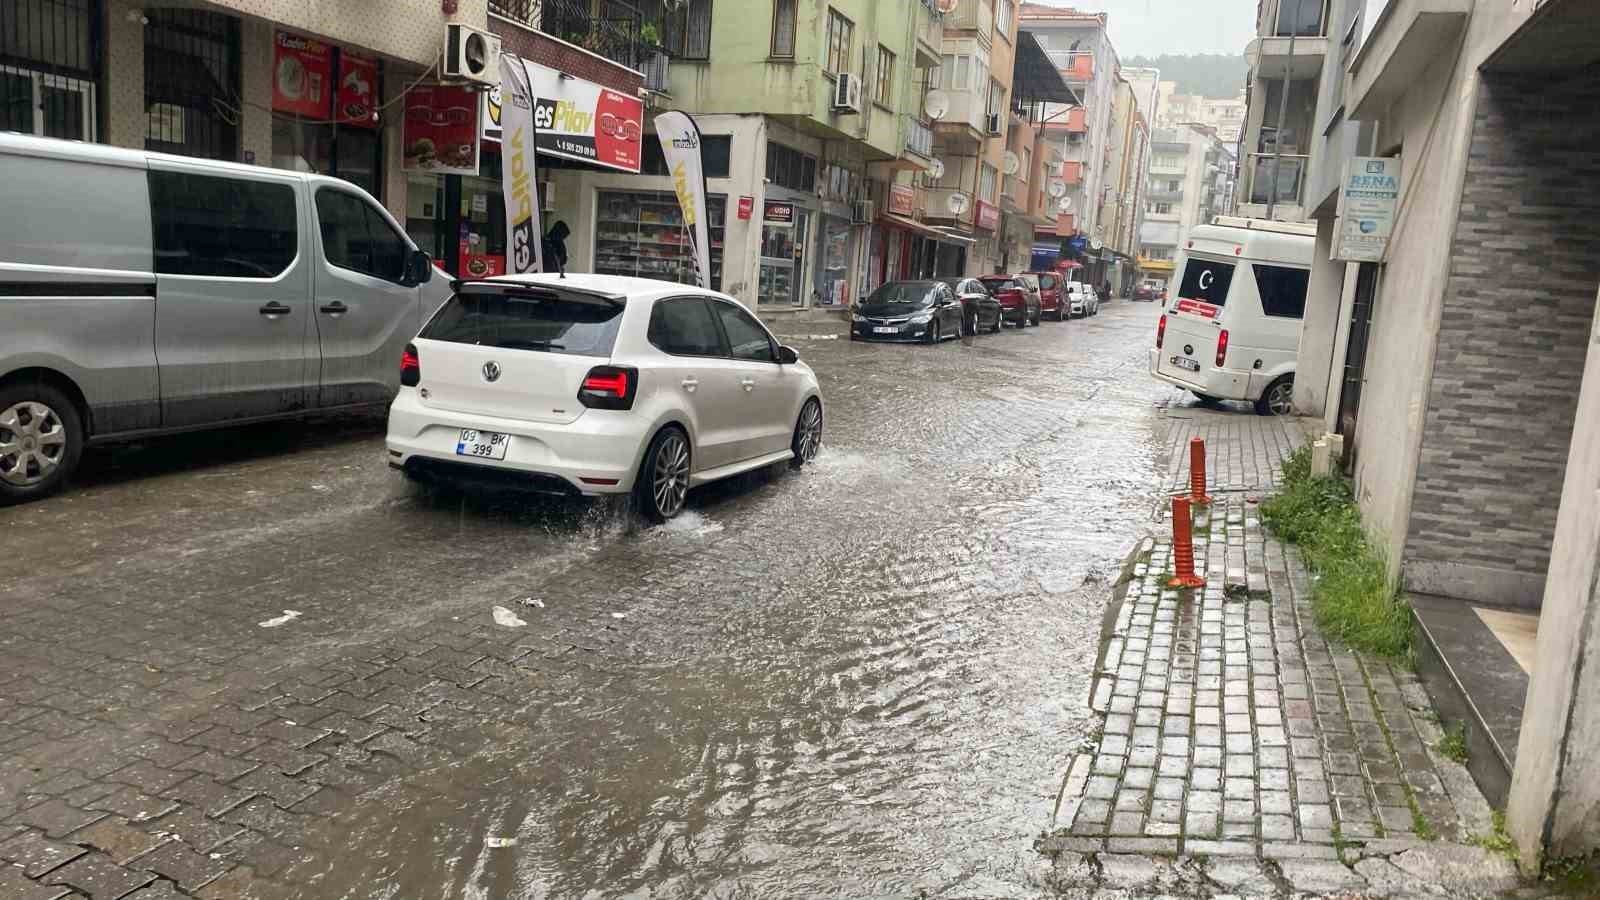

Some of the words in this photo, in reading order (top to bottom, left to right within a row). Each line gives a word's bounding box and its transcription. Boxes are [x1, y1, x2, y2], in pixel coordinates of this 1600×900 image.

[535, 99, 593, 133] esPilav
[1351, 175, 1396, 188] RENA
[463, 430, 477, 442] 09
[490, 433, 506, 446] BK
[472, 443, 492, 456] 399
